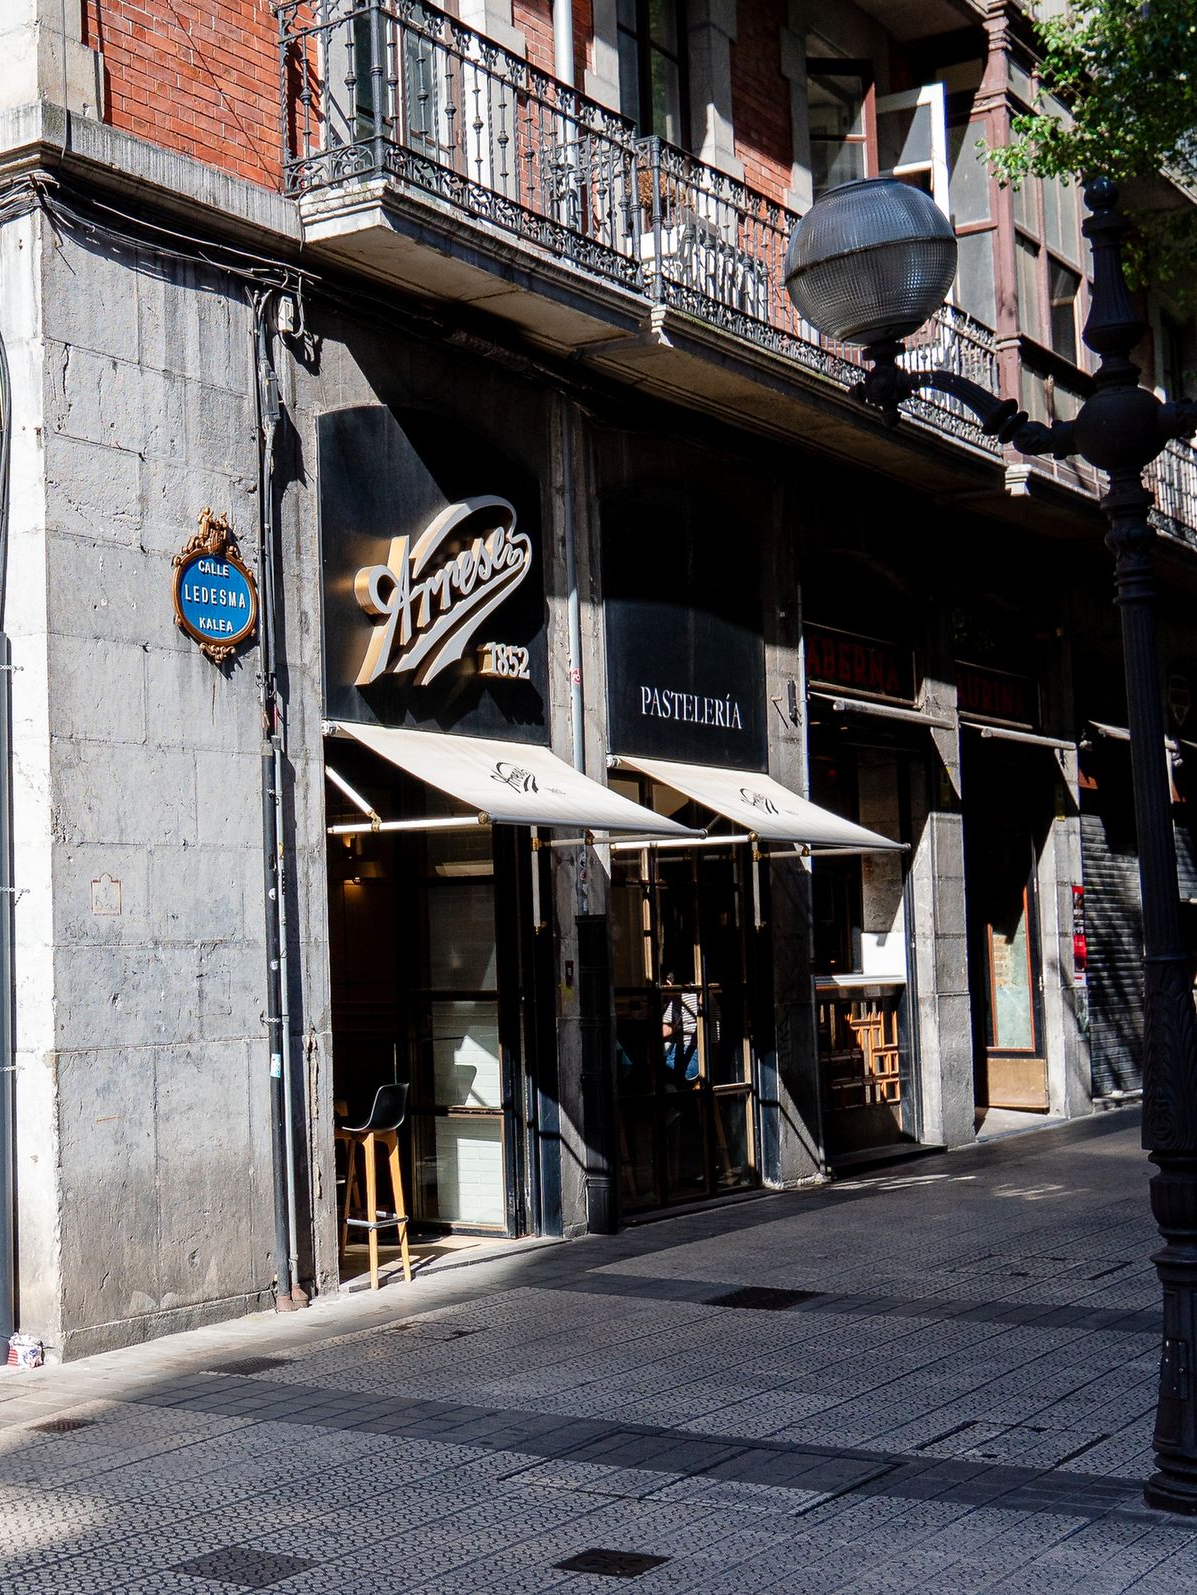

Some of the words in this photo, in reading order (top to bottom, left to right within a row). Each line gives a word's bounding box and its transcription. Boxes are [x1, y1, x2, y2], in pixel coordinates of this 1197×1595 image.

[198, 559, 230, 577] CALLE
[184, 583, 246, 609] LEDESMA
[199, 616, 234, 633] KALEA
[480, 641, 531, 680] 1852
[806, 633, 900, 692] ABERNA
[640, 686, 743, 730] PASTELERÍA
